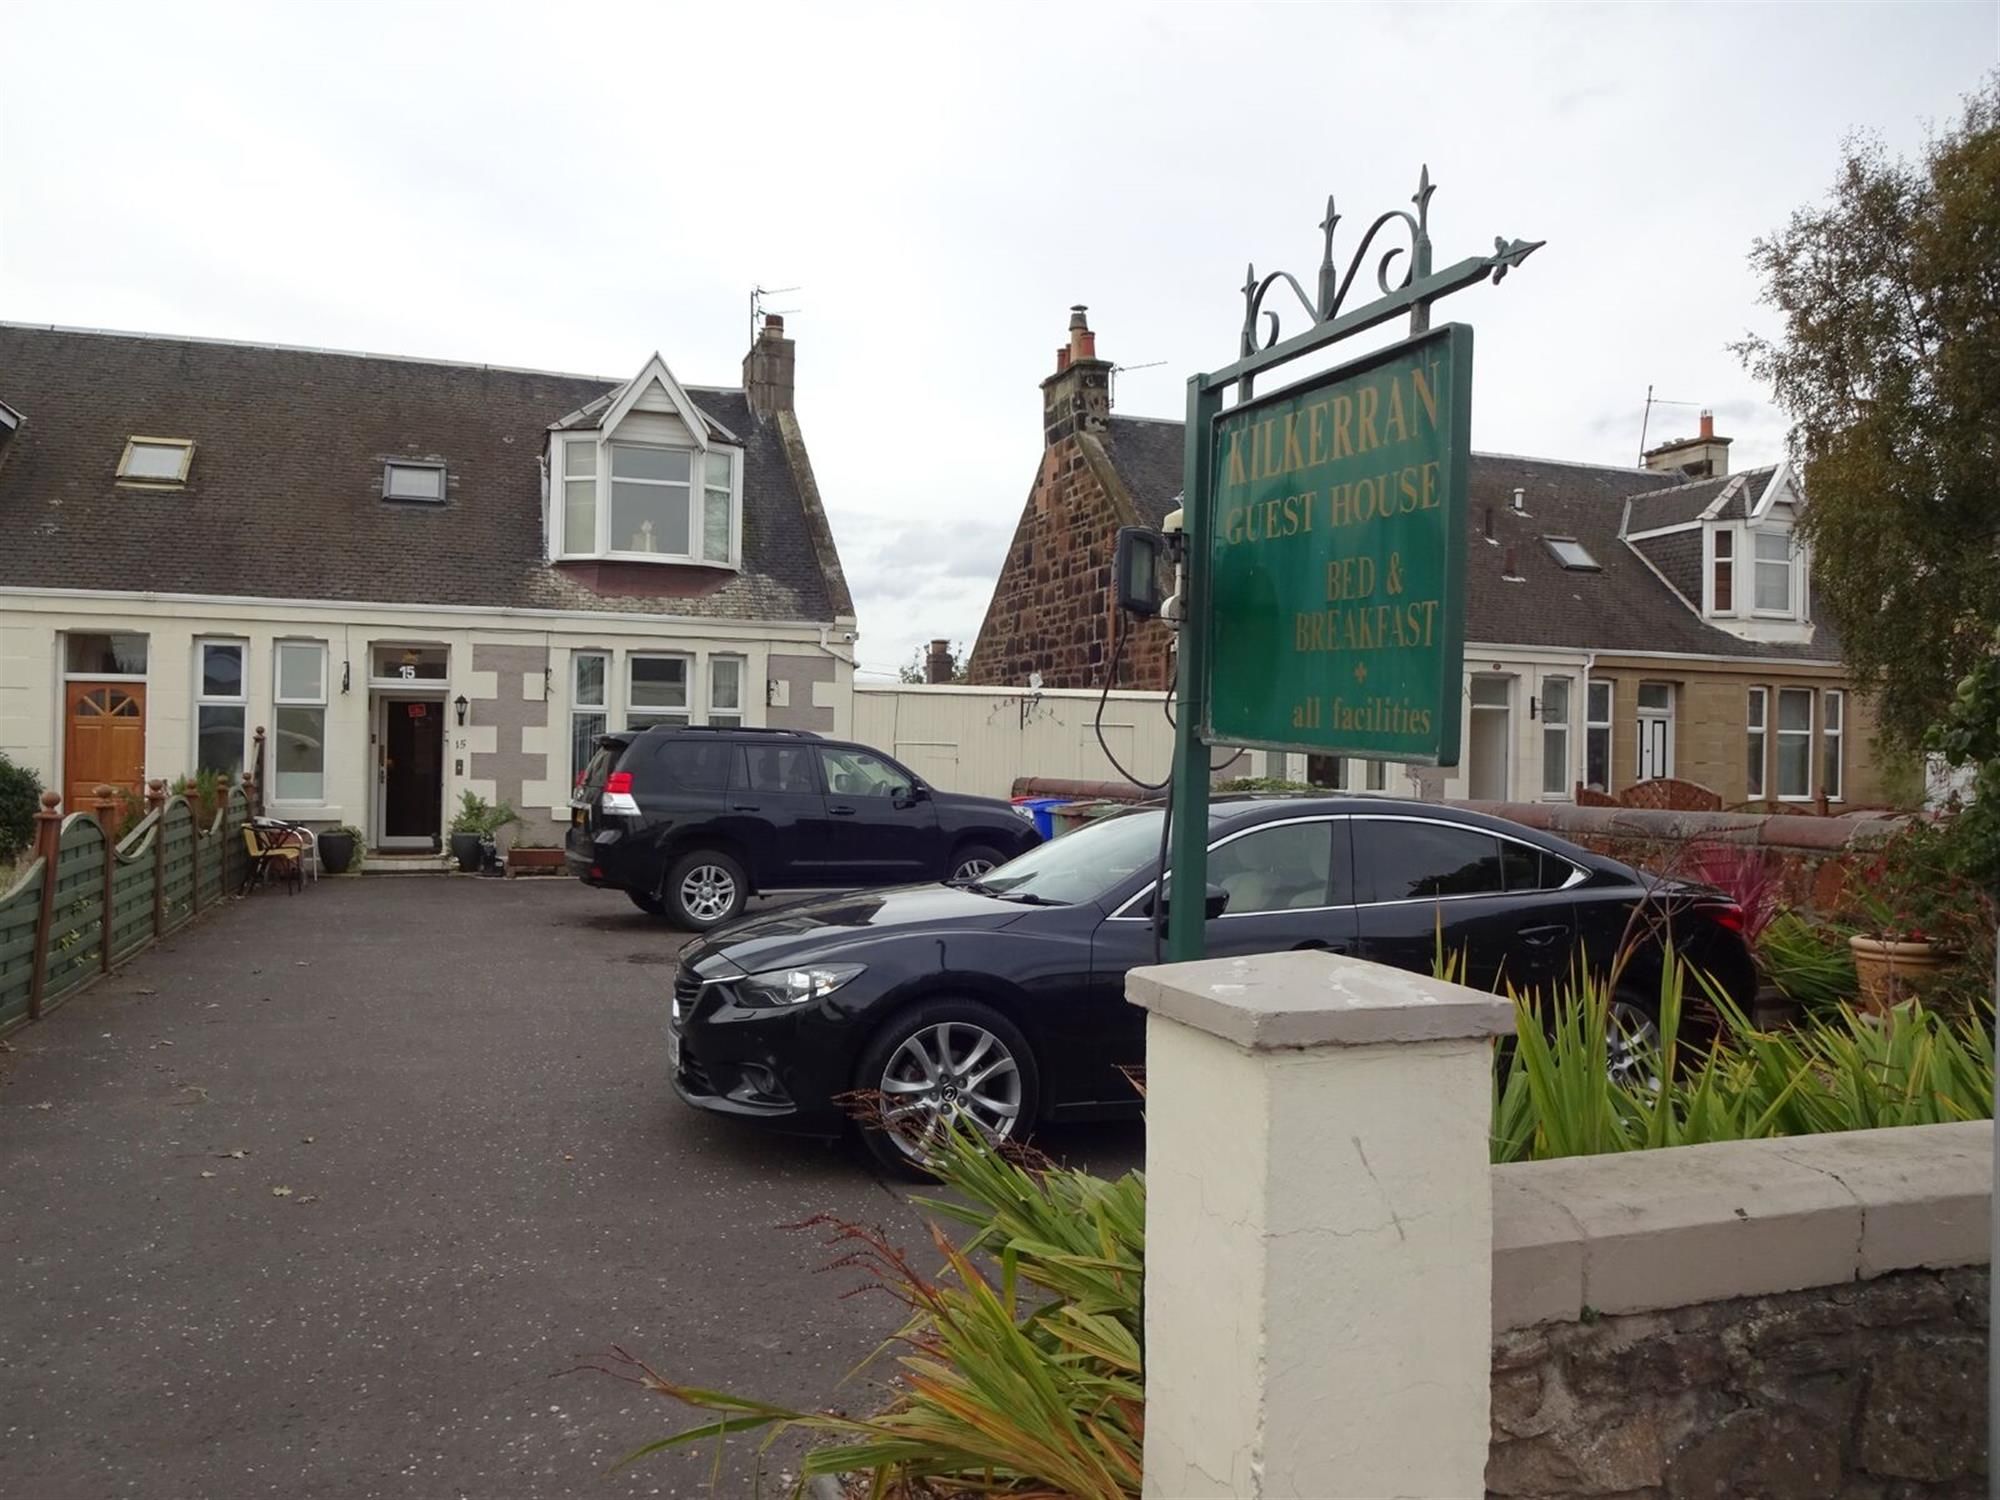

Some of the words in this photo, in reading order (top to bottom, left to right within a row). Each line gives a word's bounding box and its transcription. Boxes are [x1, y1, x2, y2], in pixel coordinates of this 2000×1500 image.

[1228, 361, 1440, 486] KILKERRAN
[1226, 492, 1317, 544] GUEST
[1330, 462, 1440, 527] HOUSE
[1327, 556, 1374, 600] BED
[1387, 552, 1403, 594] &
[1295, 601, 1438, 651] BREAKFAST
[399, 666, 415, 679] 15
[1293, 698, 1320, 729] all
[1332, 698, 1430, 734] facilities
[455, 739, 467, 749] 15
